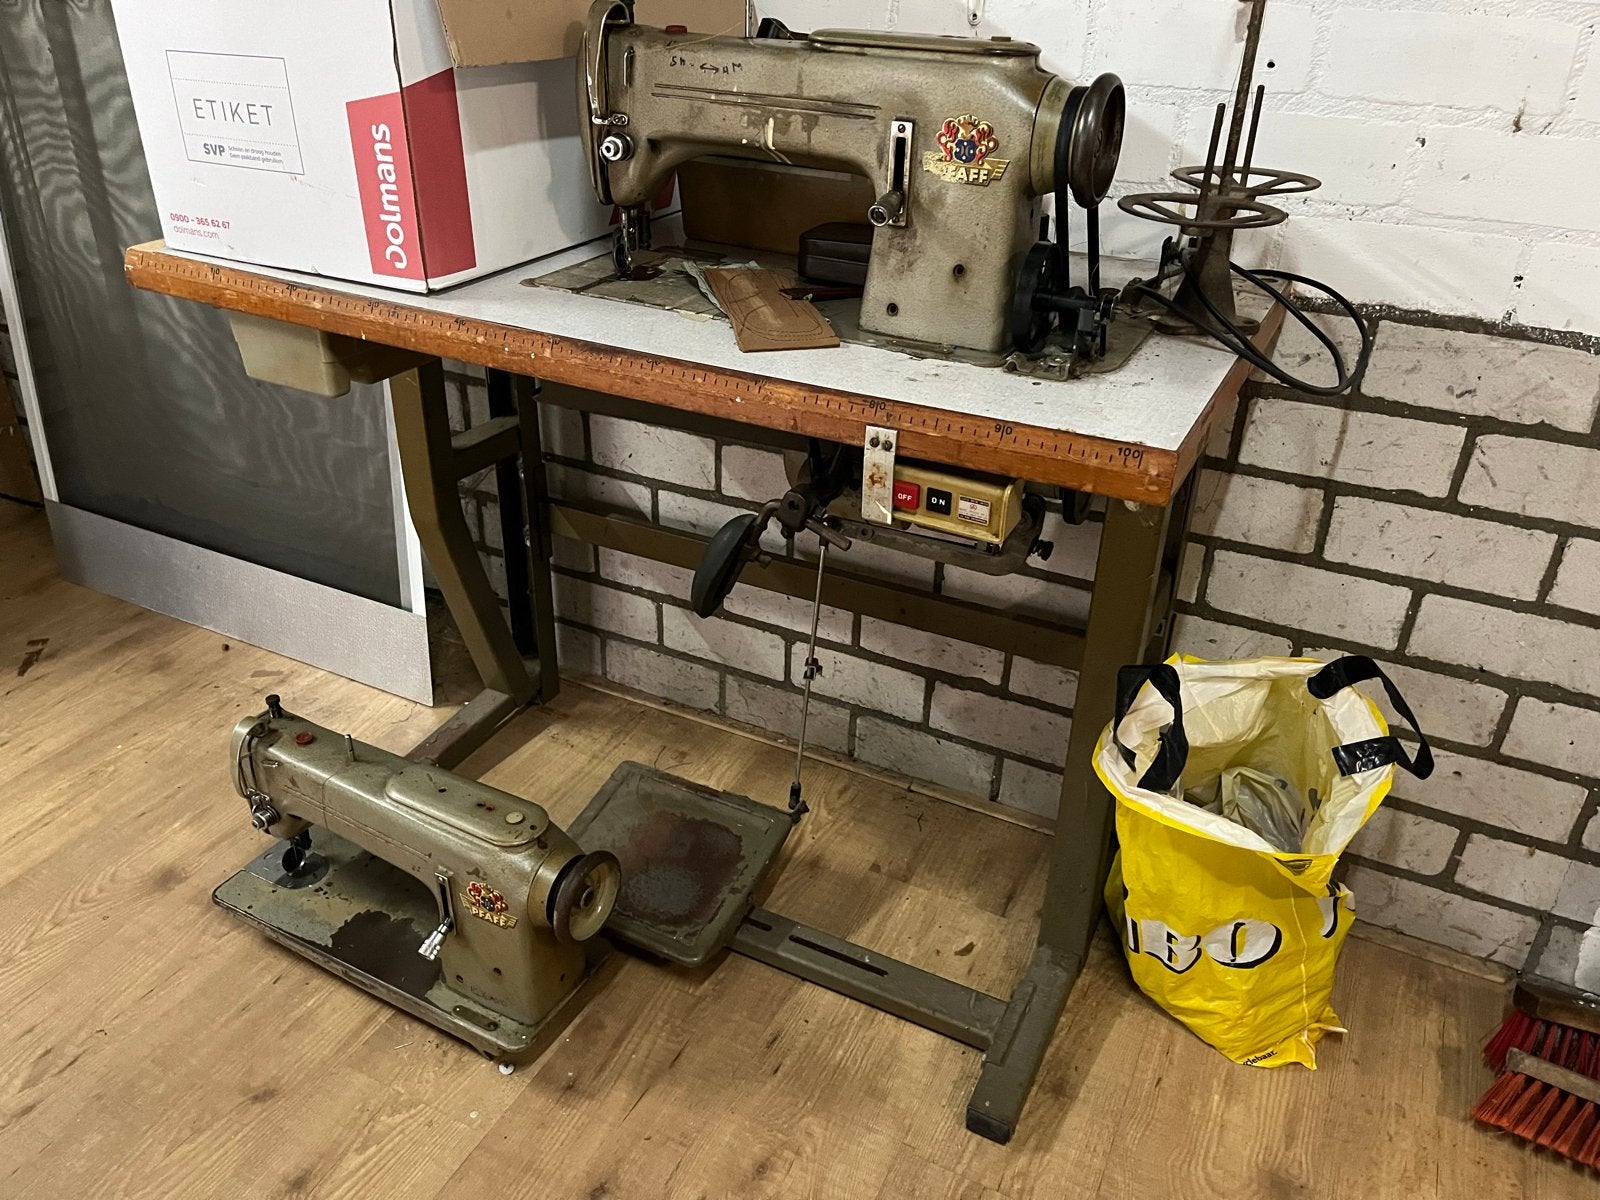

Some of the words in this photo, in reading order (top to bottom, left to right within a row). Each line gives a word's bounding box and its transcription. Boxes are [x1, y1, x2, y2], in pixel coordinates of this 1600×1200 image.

[193, 98, 273, 126] ETIKET
[203, 142, 225, 157] SVP
[170, 212, 189, 224] 0900
[196, 216, 210, 227] 365
[211, 219, 221, 228] 62
[222, 221, 230, 230] 67
[173, 225, 220, 239] dolmans.com
[868, 399, 886, 410] 80
[994, 424, 1012, 435] 90
[1117, 446, 1141, 459] 100
[897, 492, 912, 502] OFF
[931, 496, 946, 507] ON
[471, 906, 507, 927] PFAFF
[1242, 1050, 1278, 1067] clebaar.
